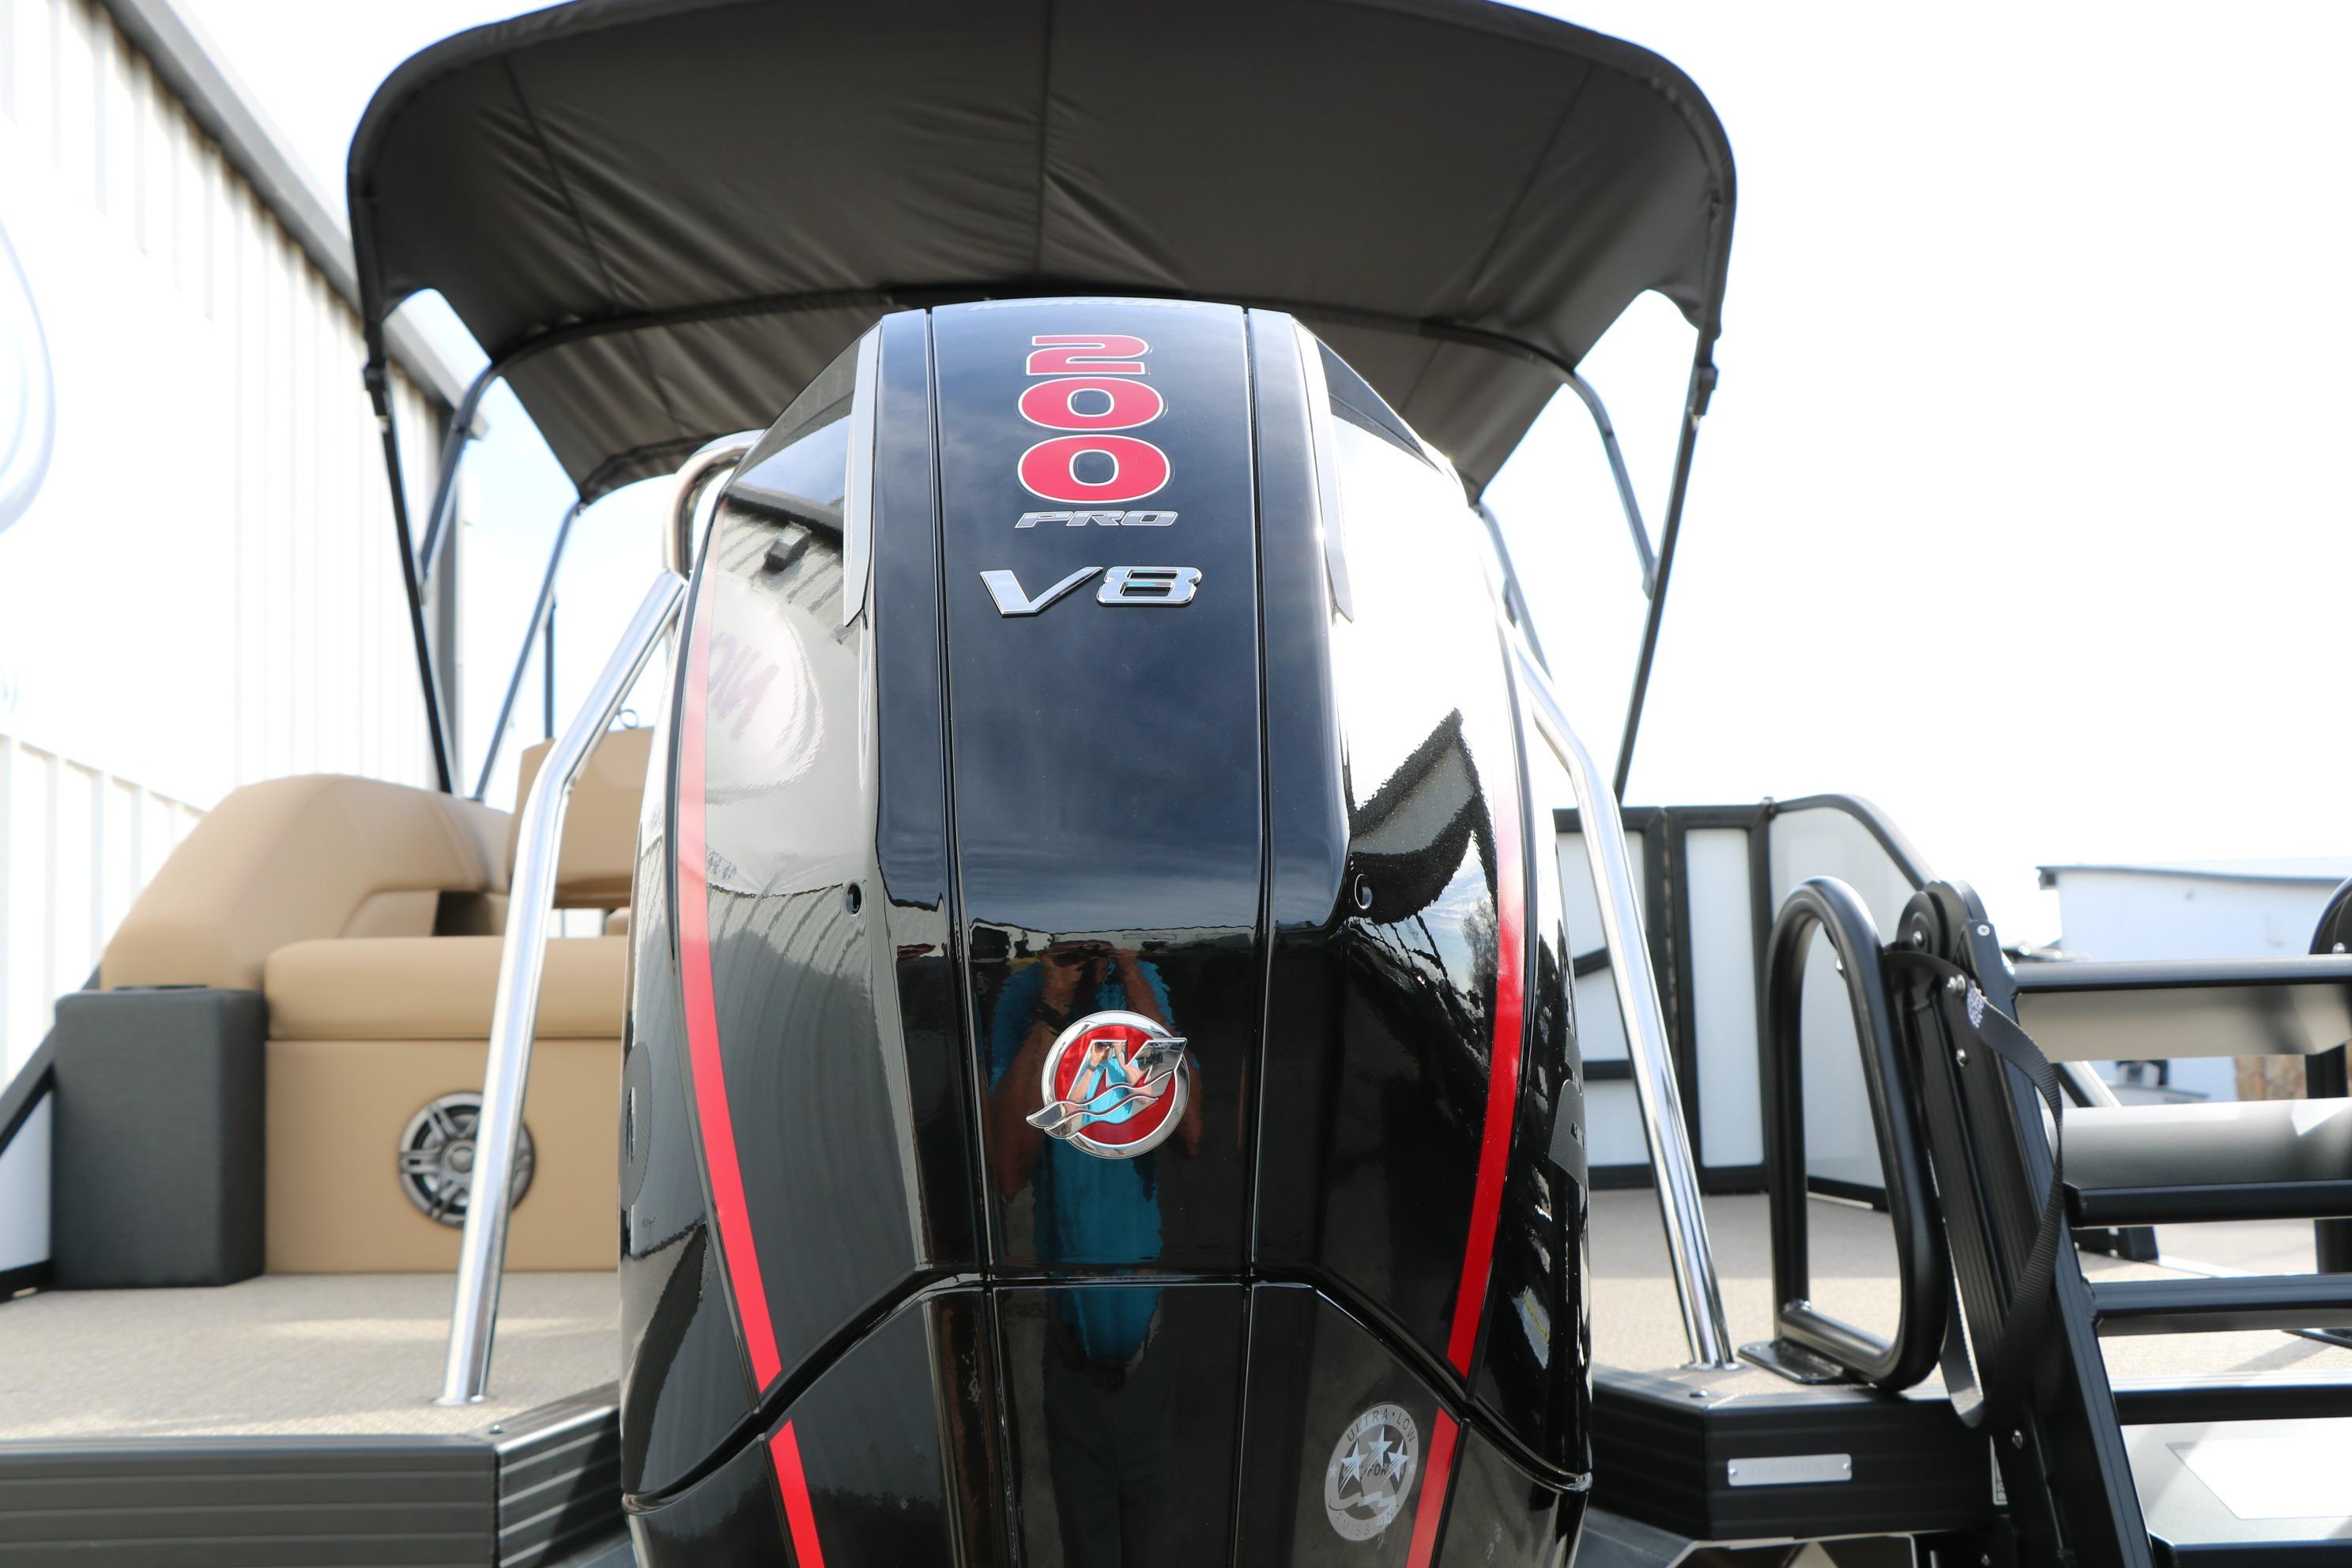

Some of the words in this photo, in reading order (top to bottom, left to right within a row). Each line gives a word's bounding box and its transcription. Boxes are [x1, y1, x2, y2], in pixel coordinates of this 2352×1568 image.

[1017, 334, 1170, 503] 200
[1015, 511, 1178, 528] PRO
[979, 565, 1204, 617] V8
[1347, 1408, 1389, 1442] ULTRA
[1396, 1412, 1416, 1442] LOW
